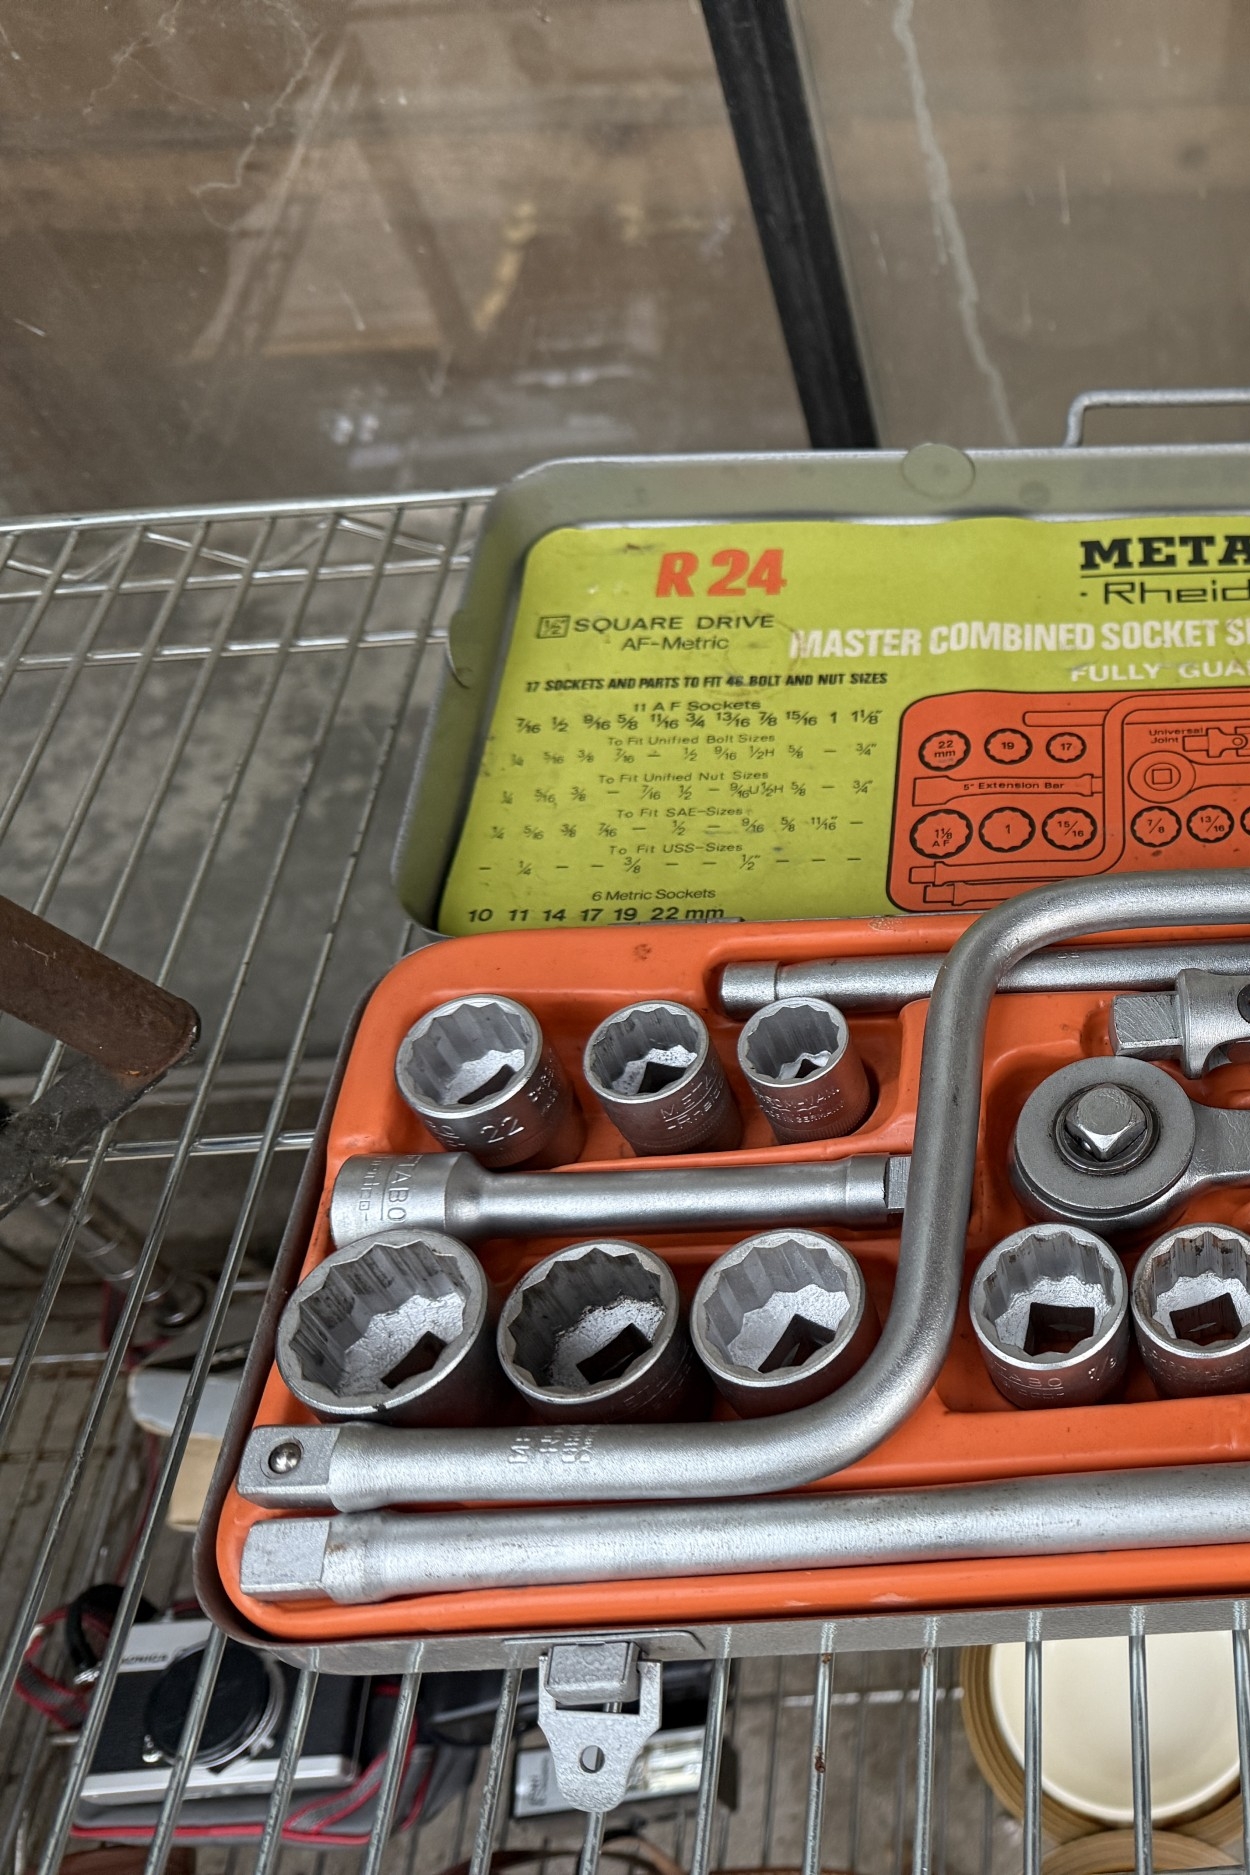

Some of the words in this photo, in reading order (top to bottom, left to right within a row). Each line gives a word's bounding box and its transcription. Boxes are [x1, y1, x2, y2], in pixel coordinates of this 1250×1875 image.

[656, 552, 699, 598] R
[707, 549, 786, 597] 24
[574, 616, 683, 634] SQUARE
[697, 614, 775, 629] DRIVE
[621, 635, 729, 651] AF-Metric
[788, 627, 921, 659] MASTER
[929, 621, 1095, 656] COMBINED
[1102, 619, 1219, 650] SOCKET
[1071, 663, 1160, 683] FULLY
[544, 678, 604, 692] SOCKETS
[608, 678, 636, 690] AND
[639, 677, 680, 689] PARTS
[684, 677, 699, 688] TO
[703, 676, 723, 688] FIT
[749, 675, 782, 687] BOLT
[786, 674, 814, 686] AND
[818, 673, 845, 685] NUT
[850, 672, 888, 684] SIZES
[687, 700, 761, 711] Sockets
[1149, 727, 1204, 737] Universal
[608, 737, 623, 746] To
[627, 736, 643, 745] Fit
[649, 735, 699, 746] Unified
[706, 734, 734, 743] Bolt
[739, 733, 776, 743] Sizes
[938, 740, 954, 749] 22
[1001, 741, 1015, 750] 19
[1060, 742, 1073, 751] 17
[934, 750, 956, 758] mm
[599, 775, 614, 784] To
[620, 774, 638, 784] Fit
[644, 773, 692, 783] Unified
[699, 771, 725, 780] Nut
[733, 771, 769, 780] Sizes
[978, 781, 1040, 790] Extension
[1044, 781, 1065, 789] Bar
[617, 809, 633, 819] To
[640, 808, 658, 817] Fit
[666, 806, 743, 818] SAE-Sizes
[610, 845, 627, 855] To
[637, 844, 655, 854] Fit
[663, 843, 743, 854] USS-Sizes
[592, 891, 602, 901] 6
[606, 890, 653, 901] Metric
[655, 888, 716, 899] Sockets
[468, 908, 493, 922] 10
[508, 909, 530, 922] 11
[542, 909, 567, 921] 14
[580, 908, 603, 921] 17
[613, 907, 638, 921] 19
[650, 906, 679, 920] 22
[685, 908, 725, 919] mm
[480, 1116, 525, 1144] 22
